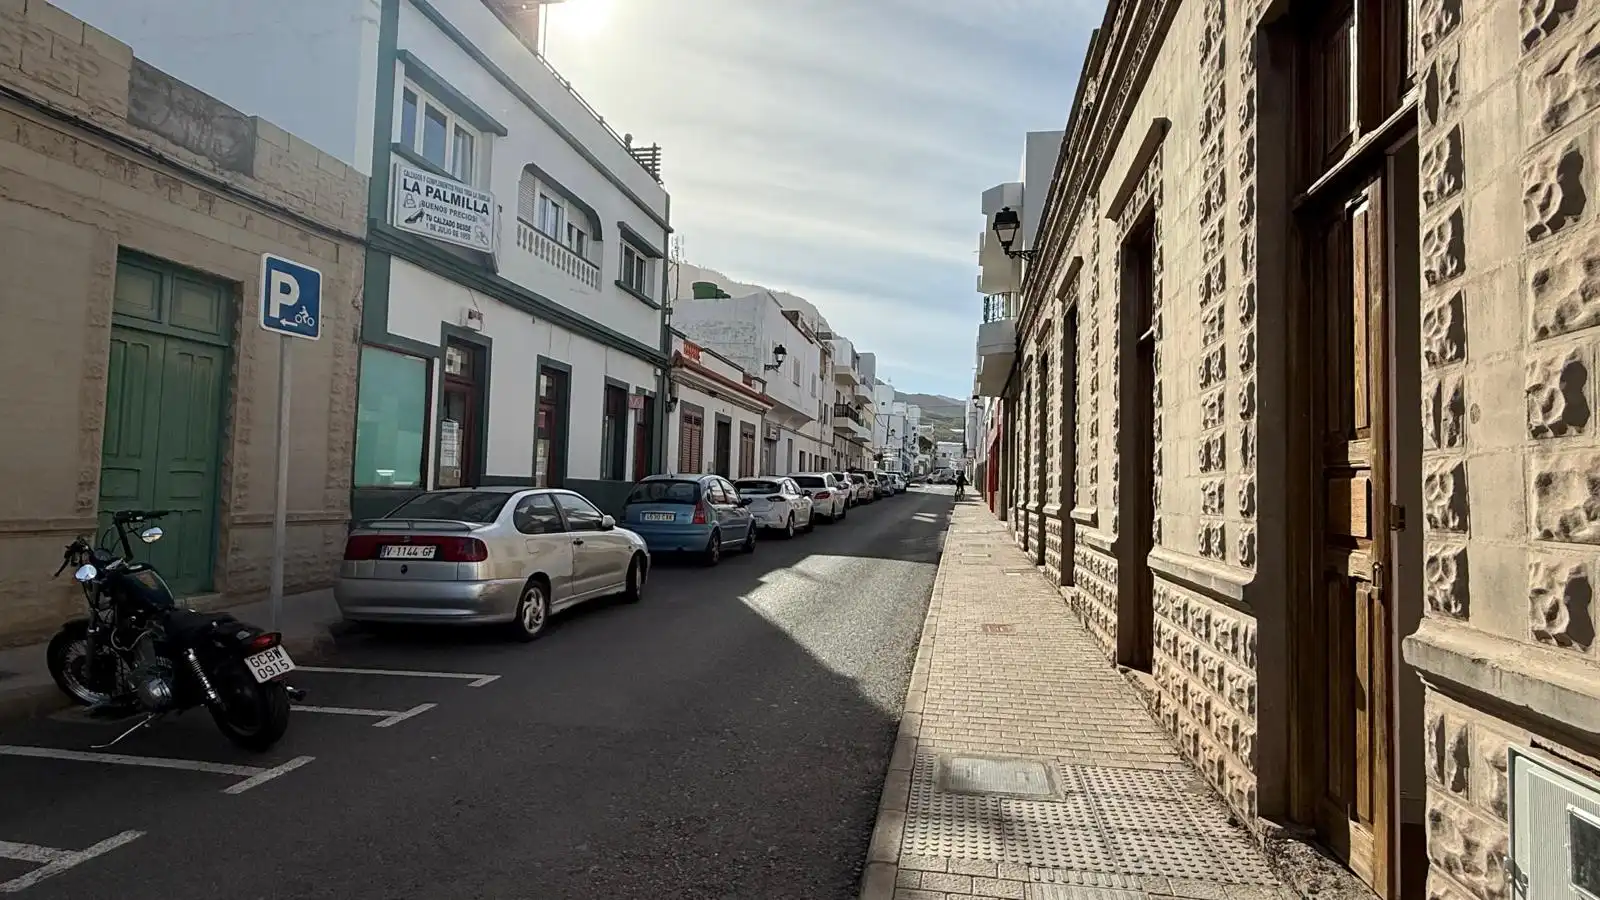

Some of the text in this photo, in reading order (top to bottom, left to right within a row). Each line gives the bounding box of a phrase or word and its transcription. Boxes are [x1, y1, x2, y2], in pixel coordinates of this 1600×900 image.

[403, 178, 489, 215] LA PALMILLA
[426, 214, 471, 233] TU CALZADO DESDE
[429, 223, 436, 231] DE
[437, 225, 451, 235] JULIO
[452, 229, 459, 237] DE
[269, 270, 300, 318] P
[250, 648, 283, 668] GCBW
[258, 659, 290, 678] 0915
